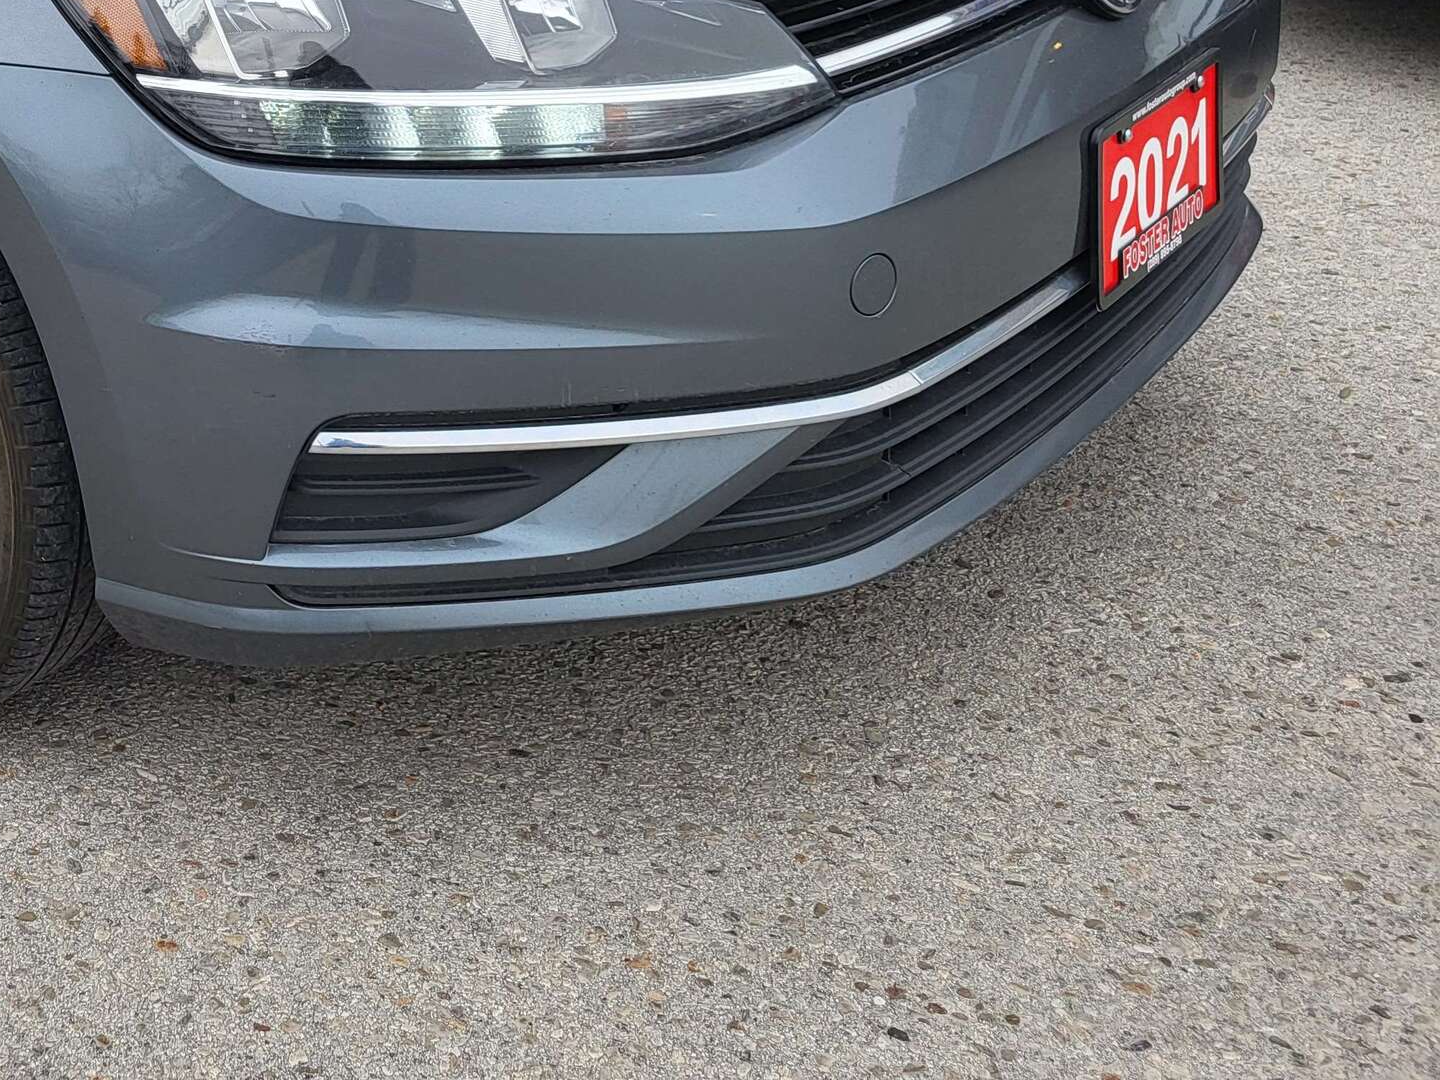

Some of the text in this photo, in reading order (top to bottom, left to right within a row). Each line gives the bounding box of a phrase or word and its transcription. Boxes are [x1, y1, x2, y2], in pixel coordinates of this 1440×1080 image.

[1110, 97, 1207, 262] 2021
[1122, 215, 1170, 280] FOSTER
[1171, 189, 1204, 242] AUTO
